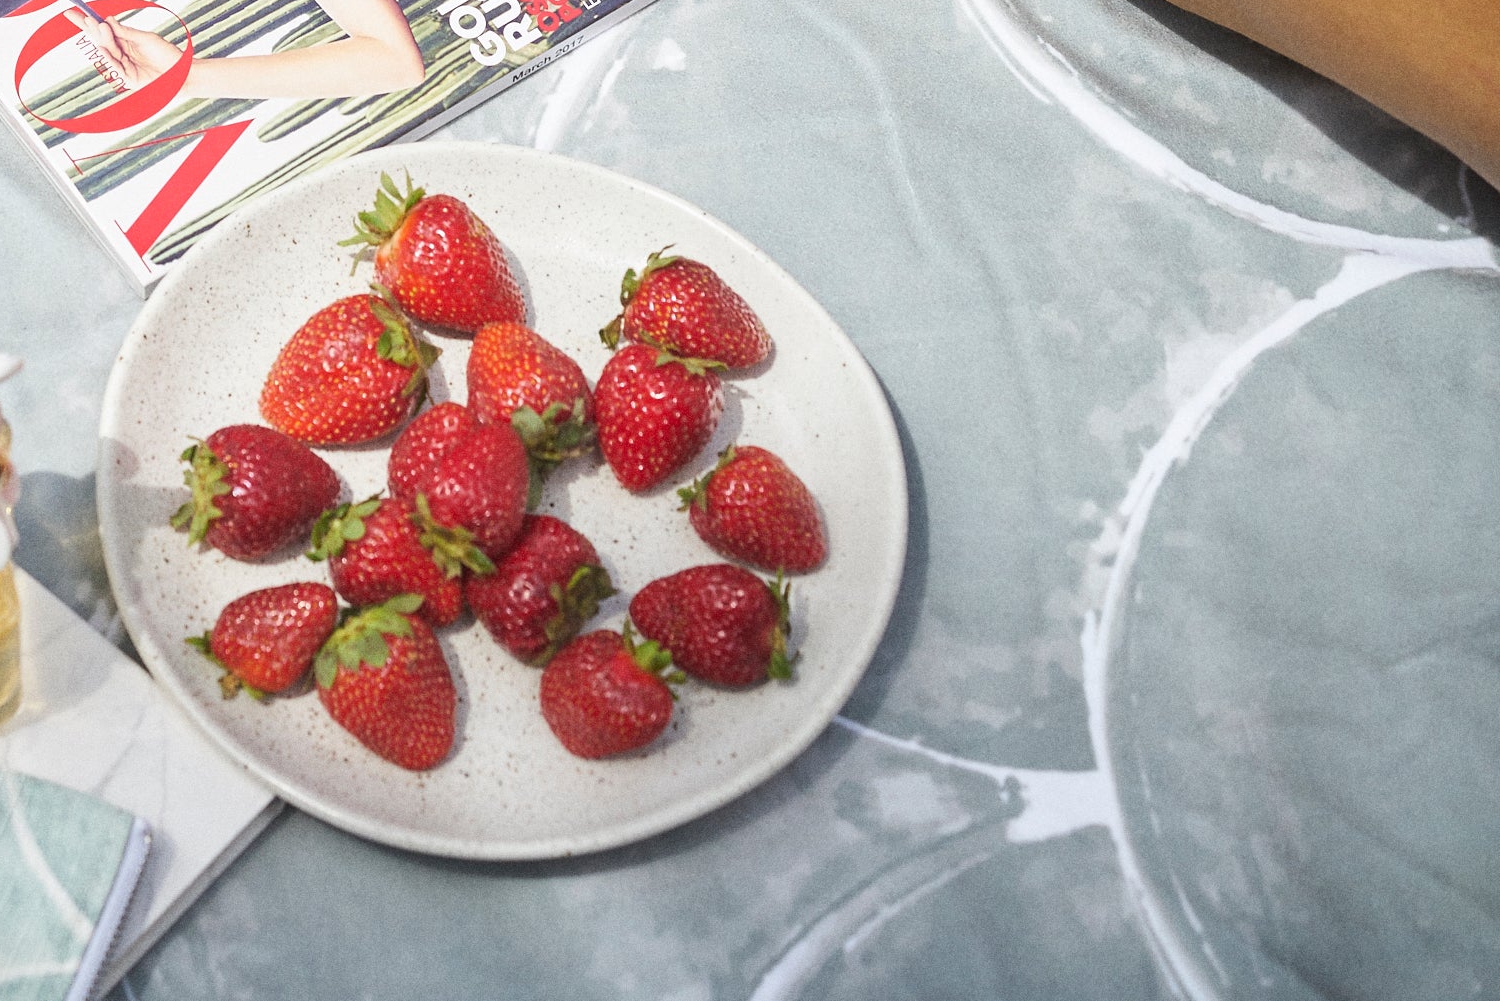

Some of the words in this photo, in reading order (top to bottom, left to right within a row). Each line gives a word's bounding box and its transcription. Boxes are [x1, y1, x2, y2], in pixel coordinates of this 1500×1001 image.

[75, 34, 130, 94] AUSTRALIA
[512, 55, 553, 81] March
[552, 34, 586, 58] 2017
